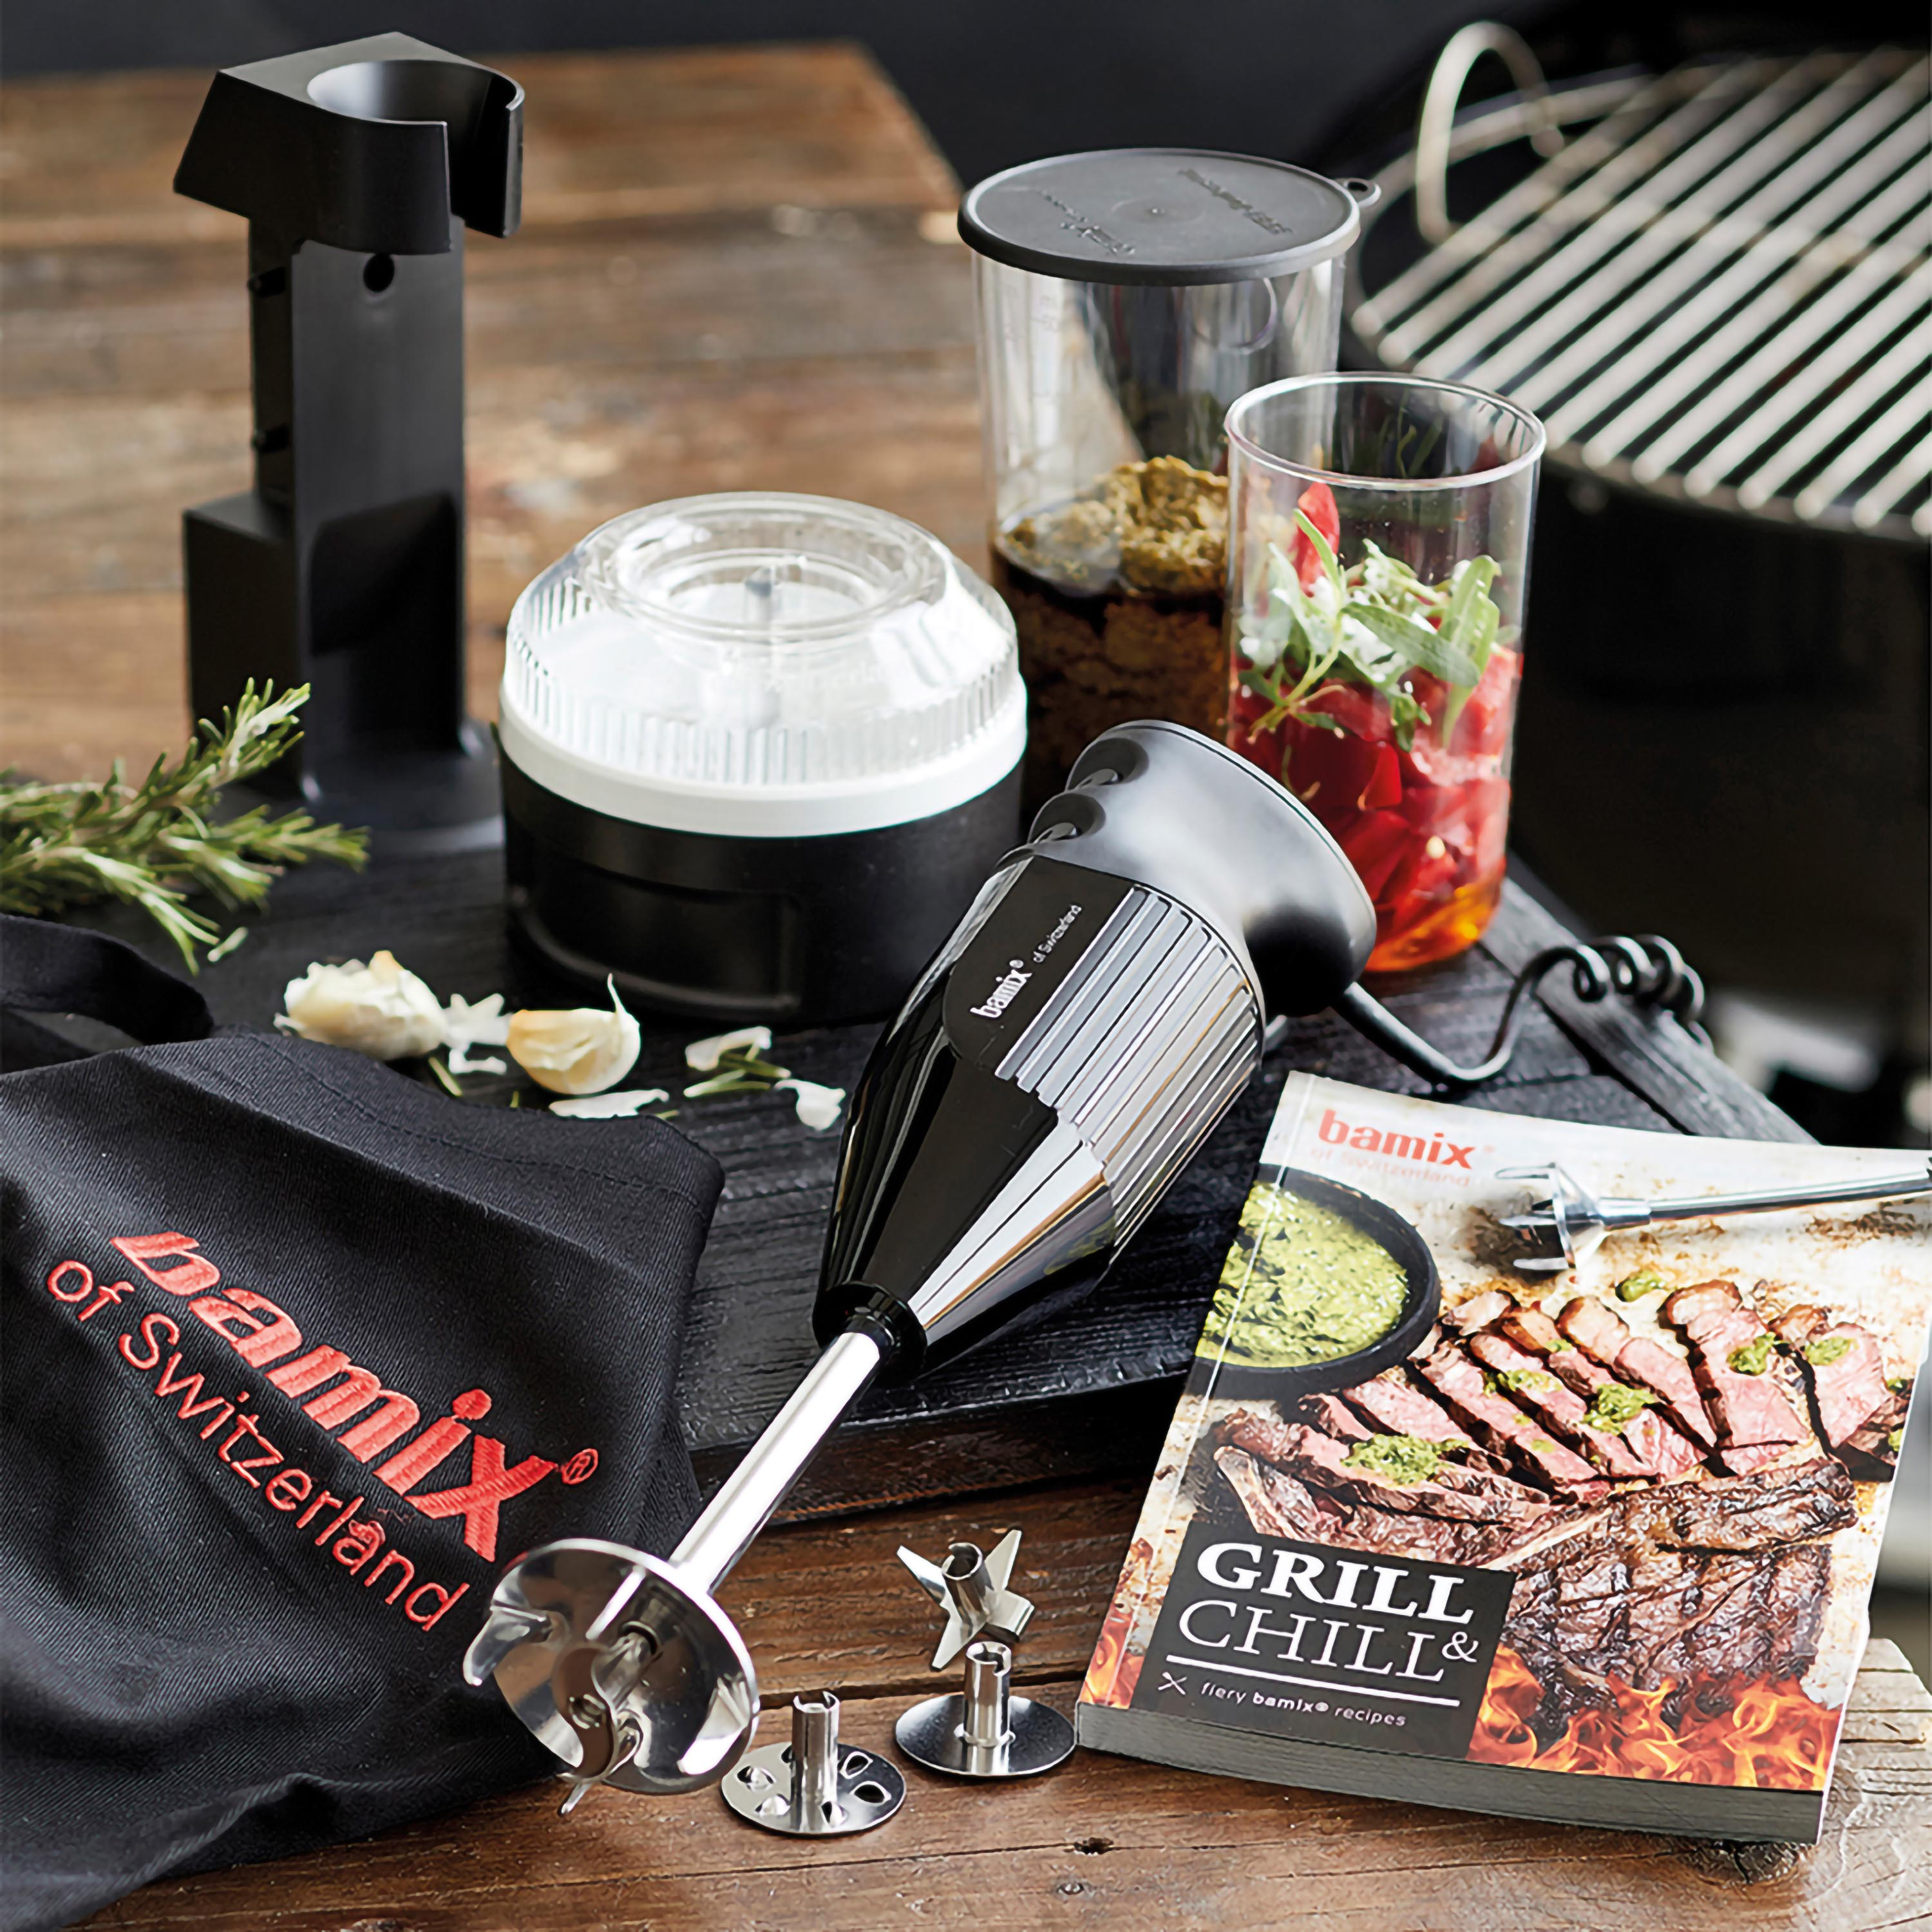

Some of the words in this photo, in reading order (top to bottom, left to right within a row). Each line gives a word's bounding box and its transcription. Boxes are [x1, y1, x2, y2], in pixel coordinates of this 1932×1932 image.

[47, 1260, 135, 1322] of
[119, 1313, 470, 1632] Switzerland
[1197, 1542, 1474, 1625] GRILL
[1179, 1600, 1444, 1683] CHILL
[1441, 1631, 1479, 1663] &
[1201, 1682, 1247, 1705] fiery
[1334, 1707, 1406, 1726] recipes
